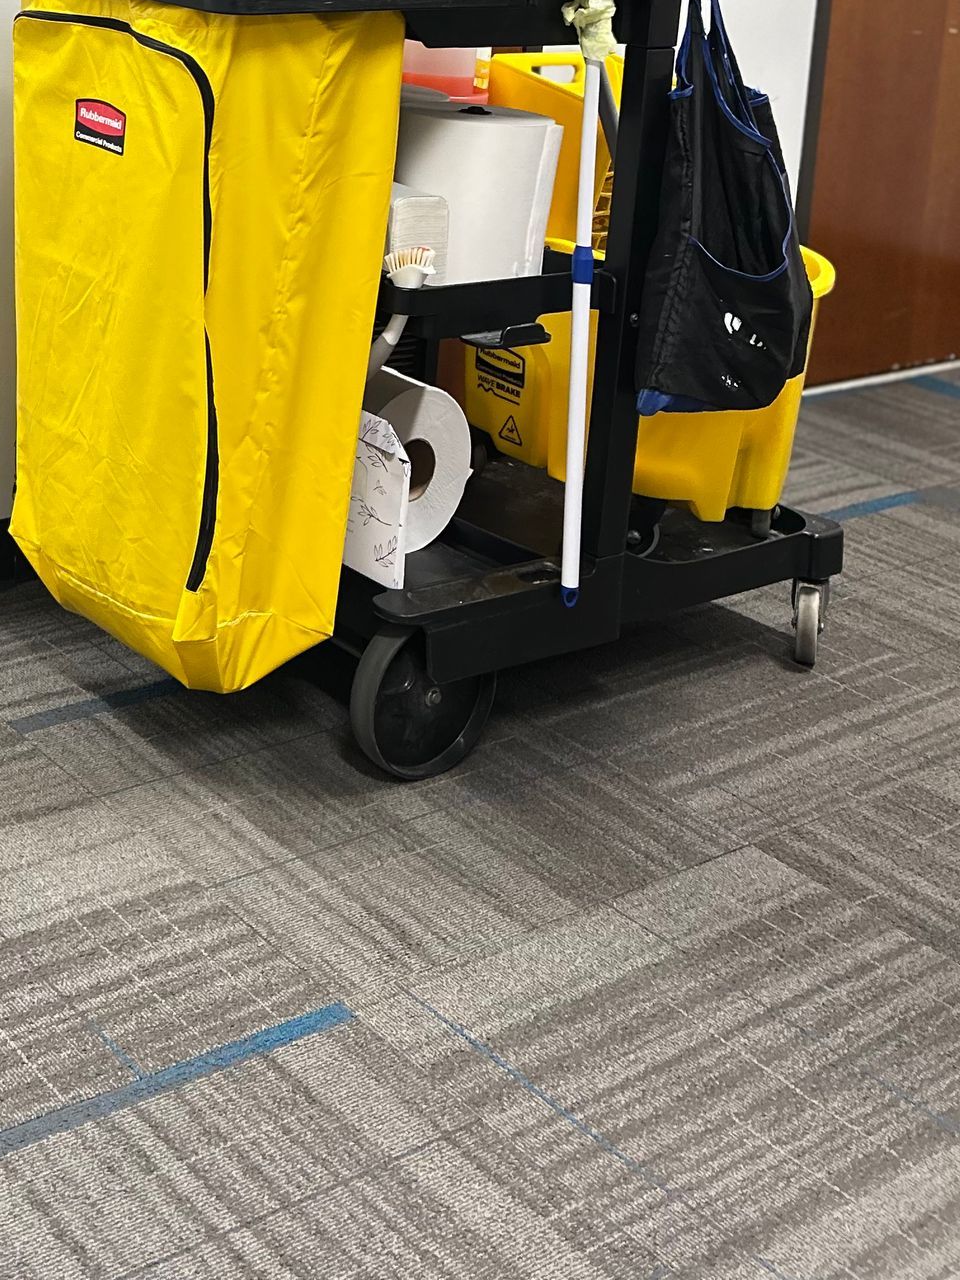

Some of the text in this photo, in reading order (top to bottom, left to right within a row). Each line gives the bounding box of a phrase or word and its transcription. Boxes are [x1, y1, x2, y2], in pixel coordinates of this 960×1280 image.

[80, 107, 122, 130] Rubbermaid
[478, 374, 495, 387] WAVE
[496, 382, 520, 398] BRAKE
